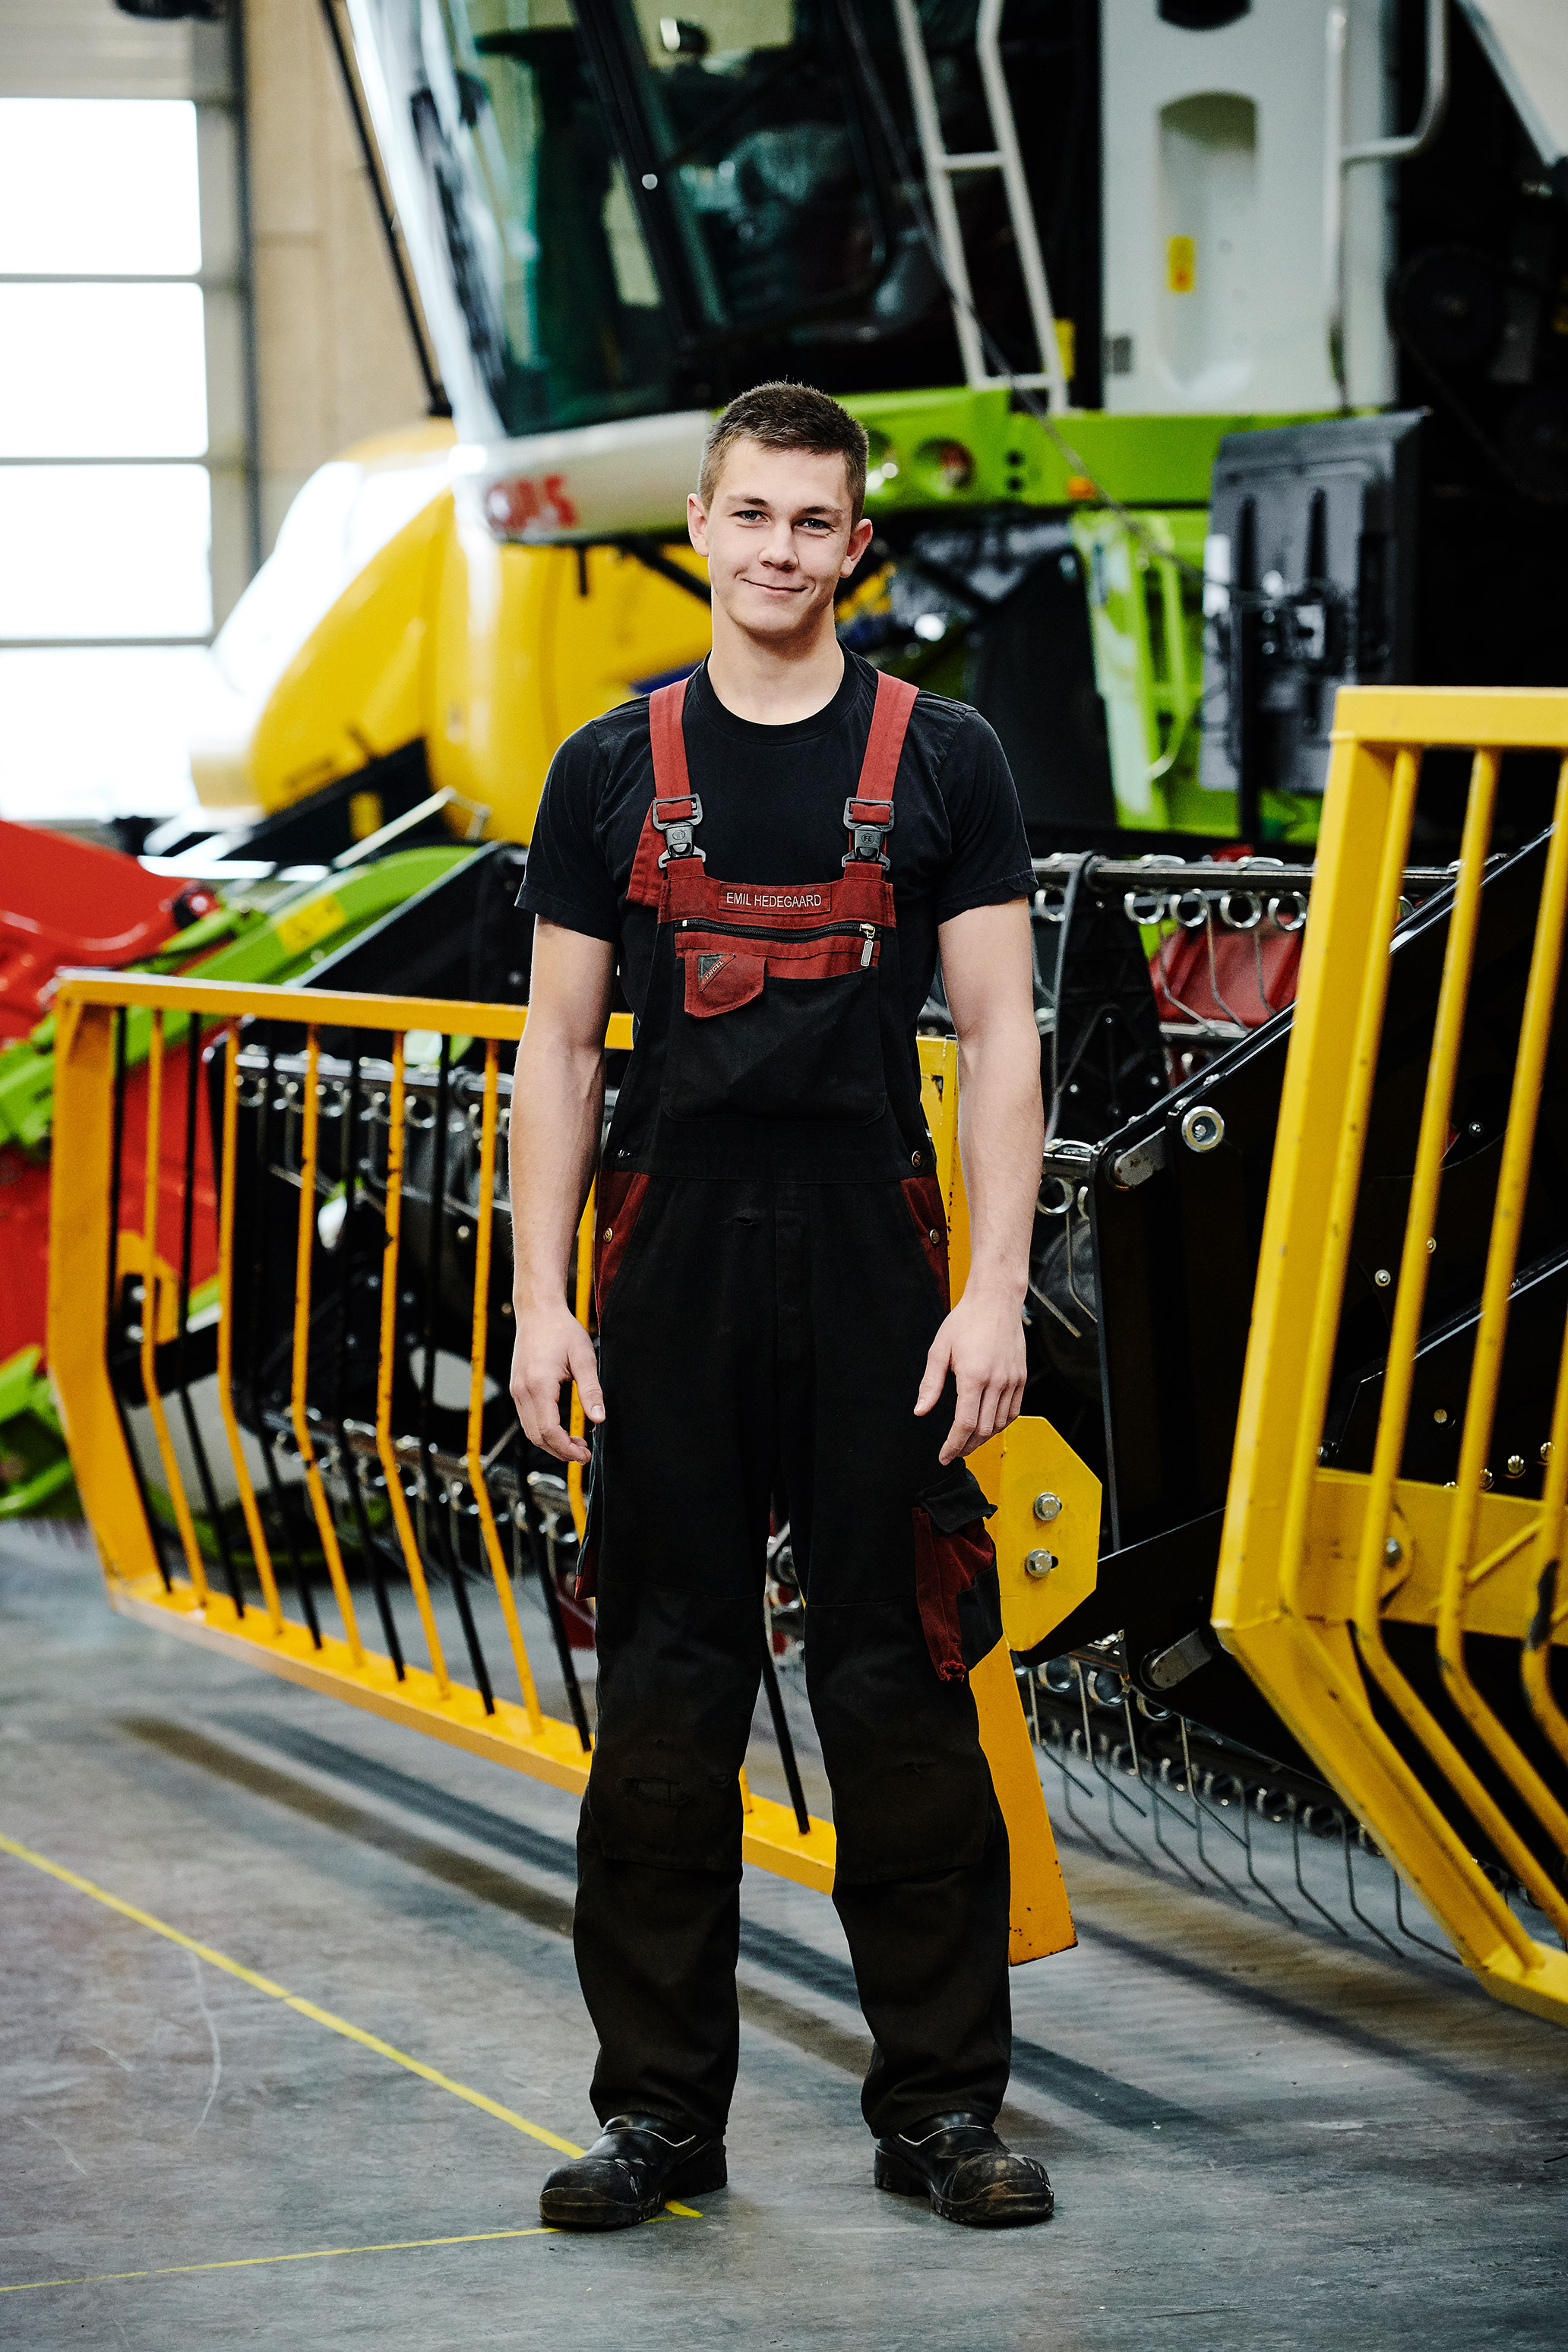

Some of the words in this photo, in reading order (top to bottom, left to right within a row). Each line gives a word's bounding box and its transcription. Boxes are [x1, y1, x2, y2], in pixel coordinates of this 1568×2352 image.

[726, 892, 751, 906] EMIL
[754, 894, 822, 908] HEDEGAARD
[705, 960, 724, 980] ENGEL
